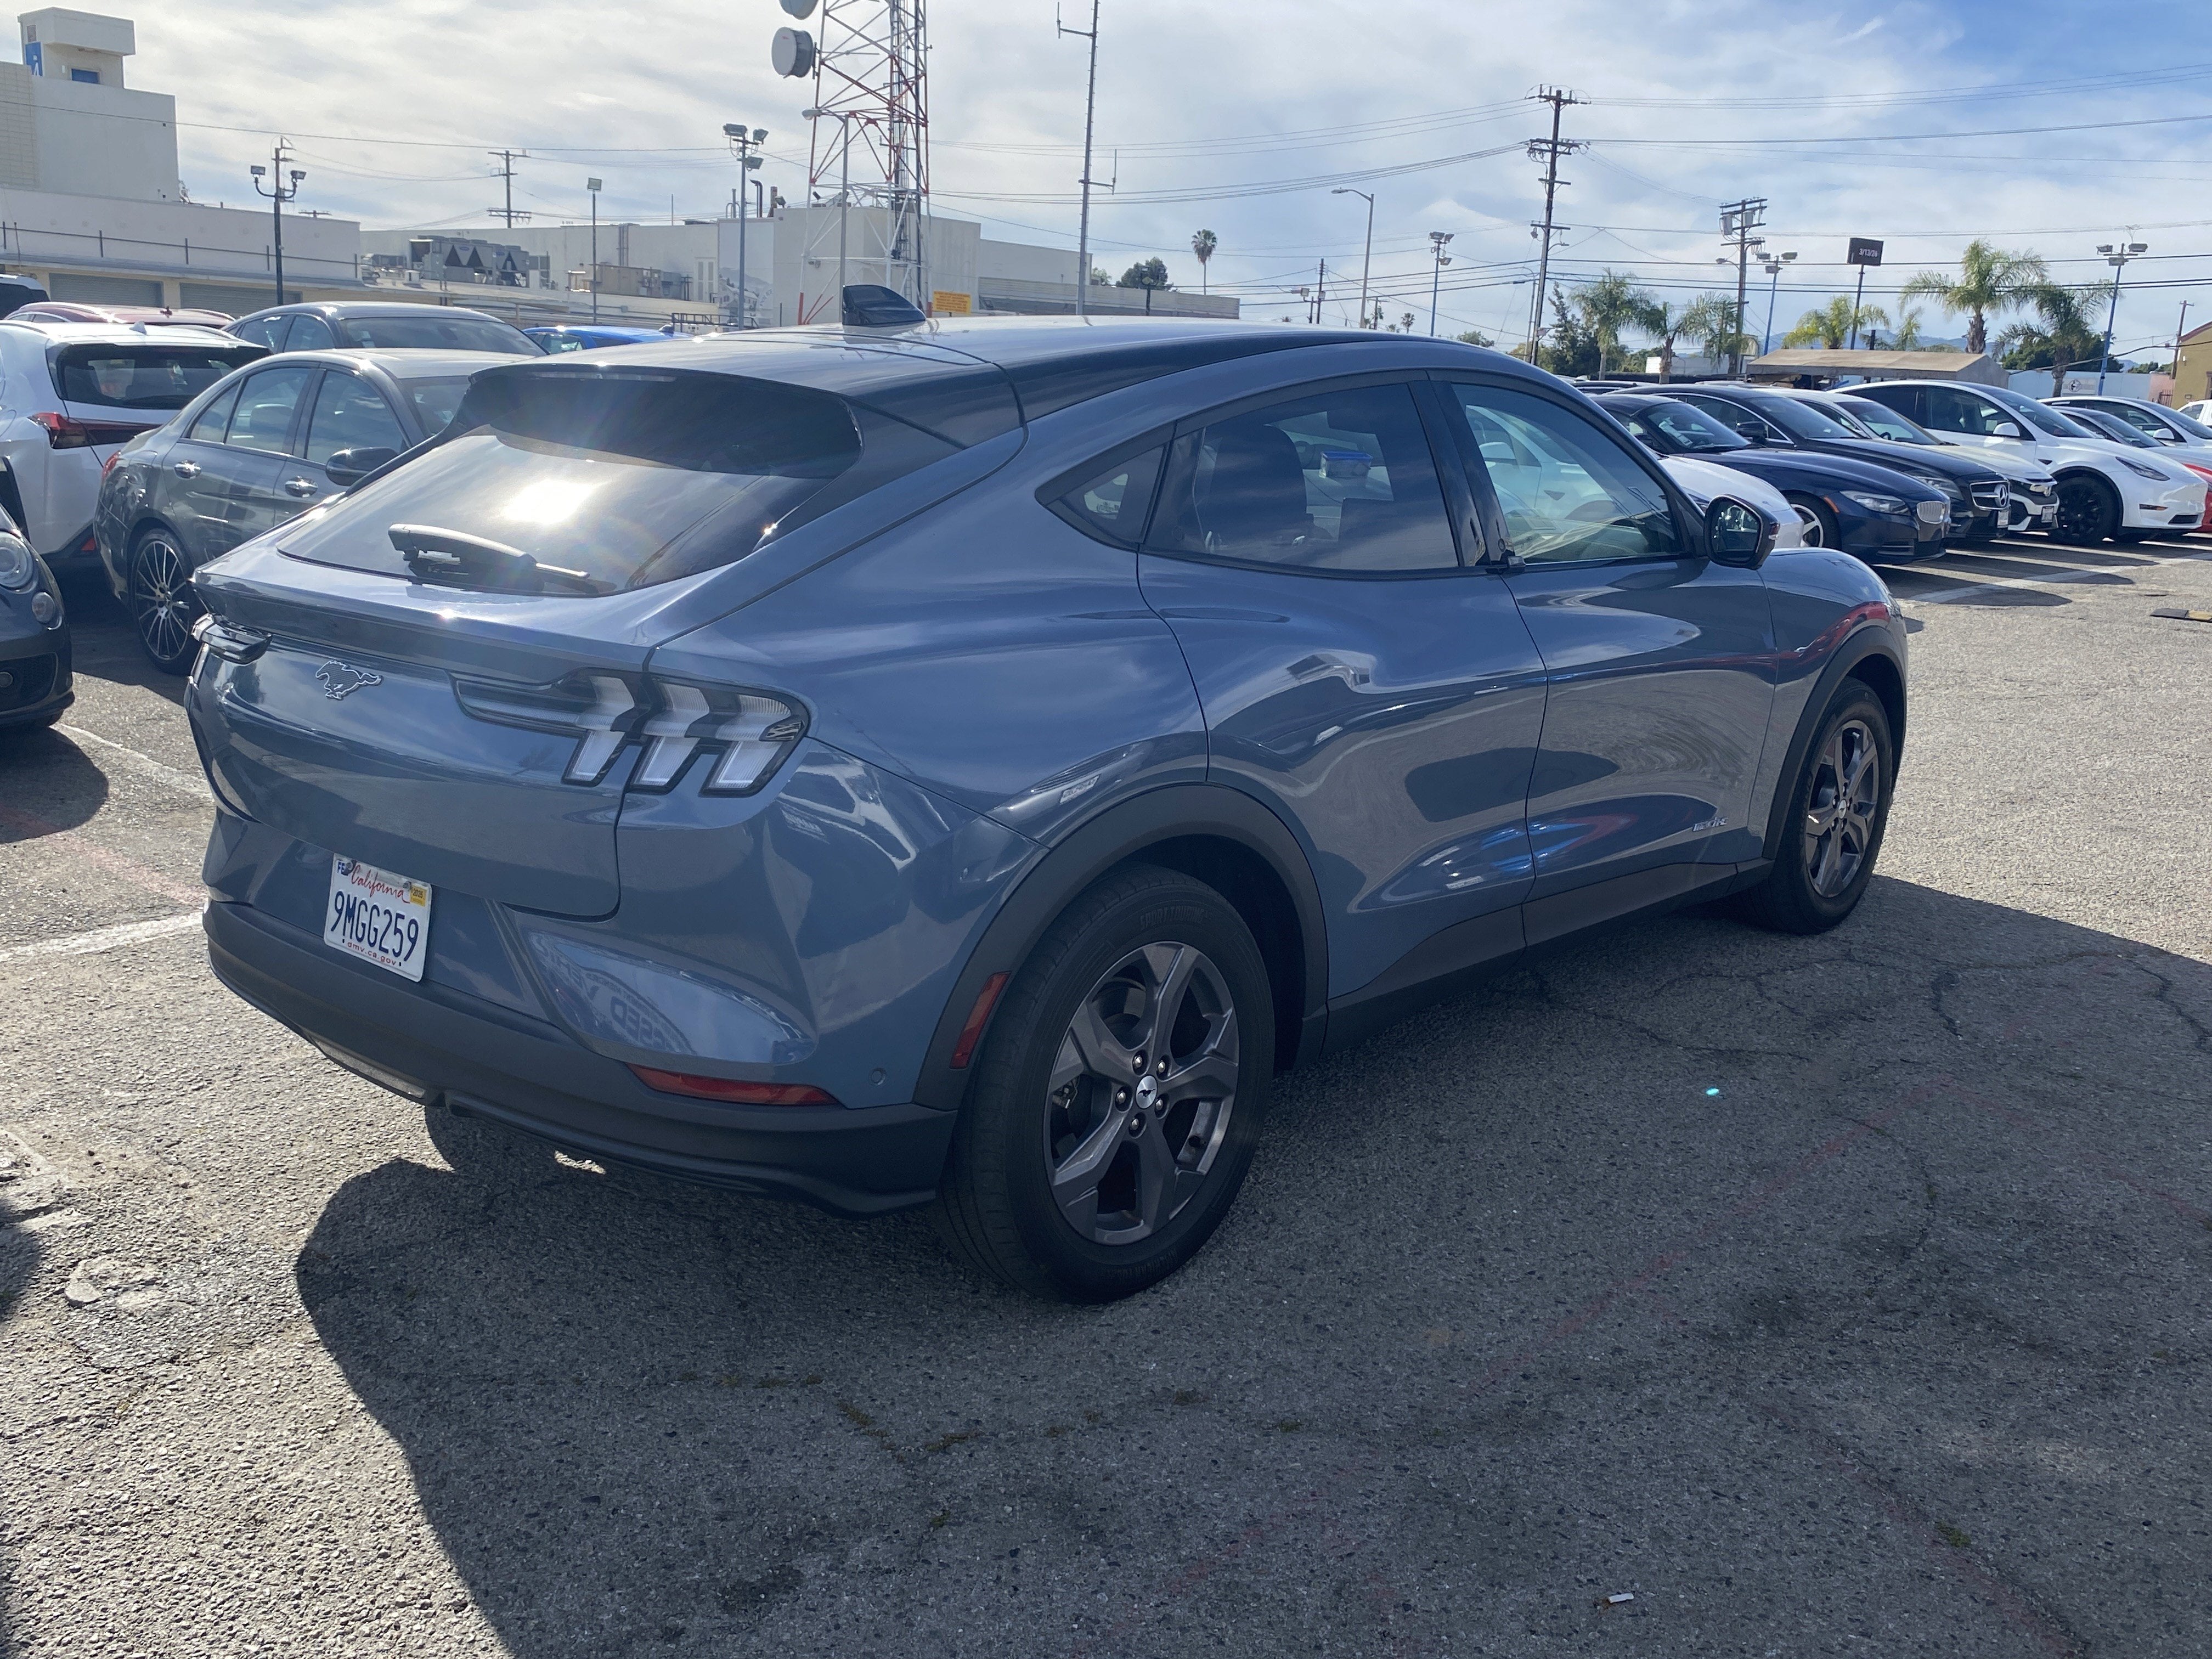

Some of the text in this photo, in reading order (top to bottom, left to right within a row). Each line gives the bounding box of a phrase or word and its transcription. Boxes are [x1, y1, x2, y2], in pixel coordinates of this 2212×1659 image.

[351, 864, 410, 903] California
[331, 891, 419, 961] 9MGG259
[347, 941, 396, 966] dmv.ca.gov
